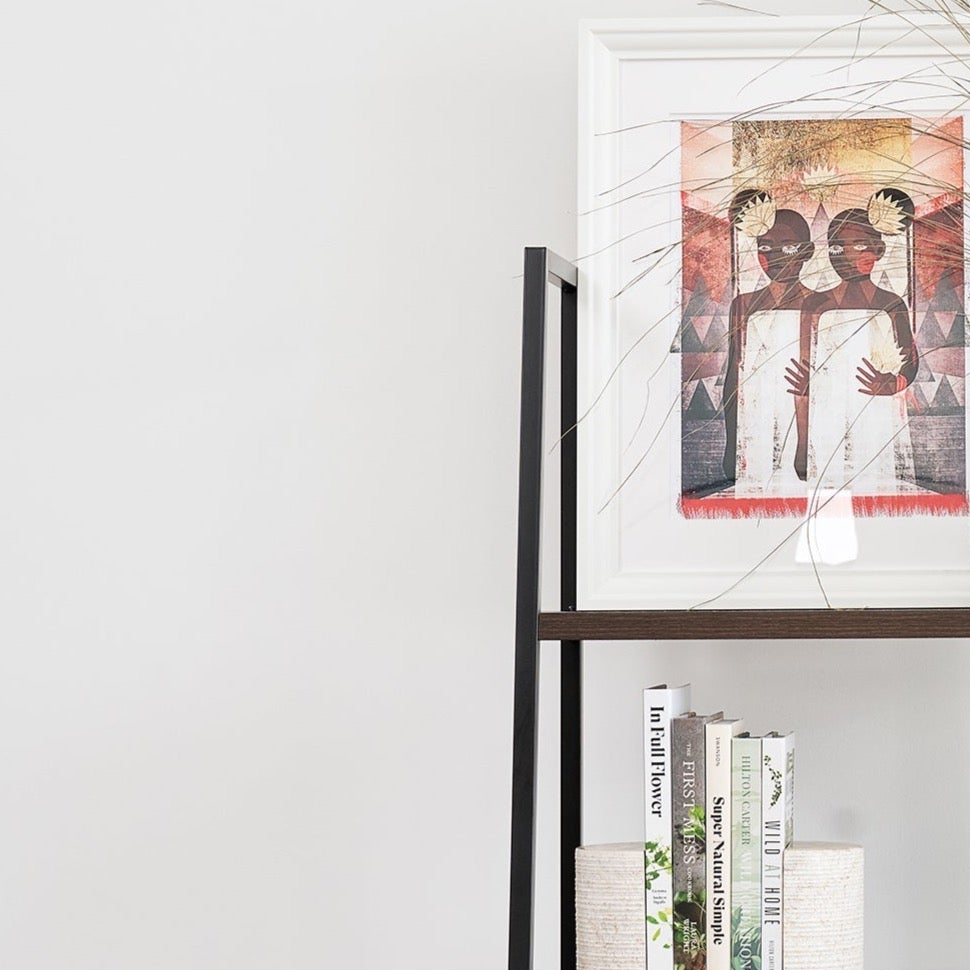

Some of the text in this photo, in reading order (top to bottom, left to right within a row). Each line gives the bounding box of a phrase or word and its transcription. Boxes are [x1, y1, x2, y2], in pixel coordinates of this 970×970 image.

[650, 706, 666, 818] In Full Flower
[682, 760, 695, 808] FIRST
[741, 755, 751, 798] HILTON
[682, 817, 696, 864] MESS
[741, 800, 751, 846] CARTER
[710, 796, 725, 945] Super Natural Simple
[764, 820, 781, 925] WILD AT HOME
